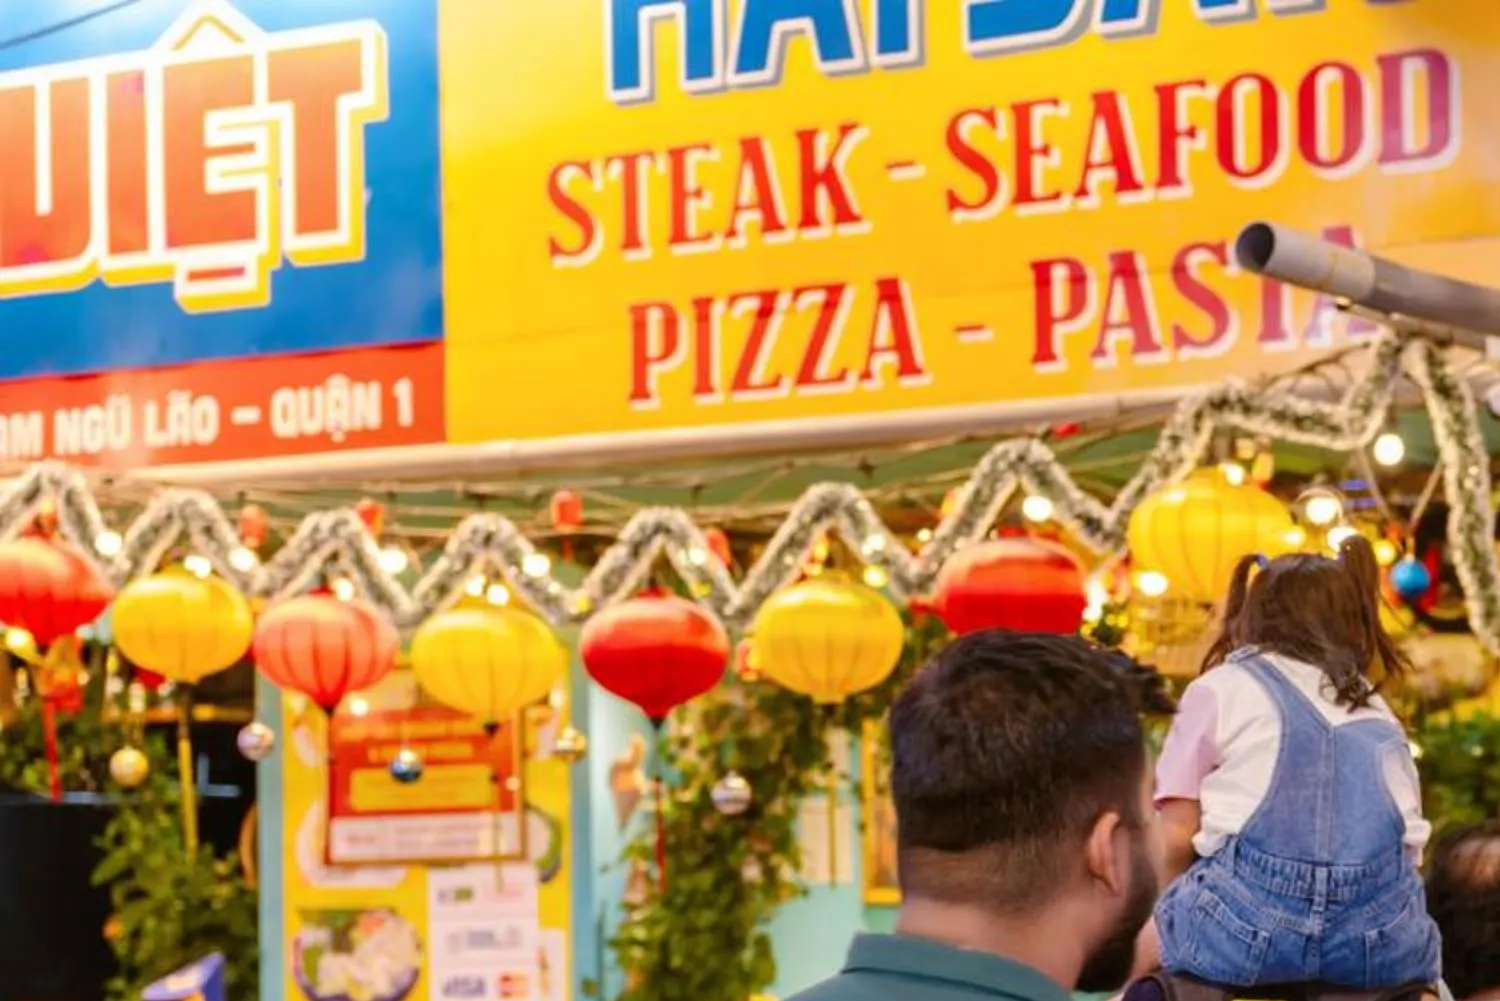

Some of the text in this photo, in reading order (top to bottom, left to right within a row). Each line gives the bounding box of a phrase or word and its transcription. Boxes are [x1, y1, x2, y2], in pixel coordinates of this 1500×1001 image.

[546, 122, 871, 267] STEAK
[945, 48, 1459, 218] SEAFOOD
[394, 377, 413, 427] 1
[628, 277, 931, 408] PIZZA
